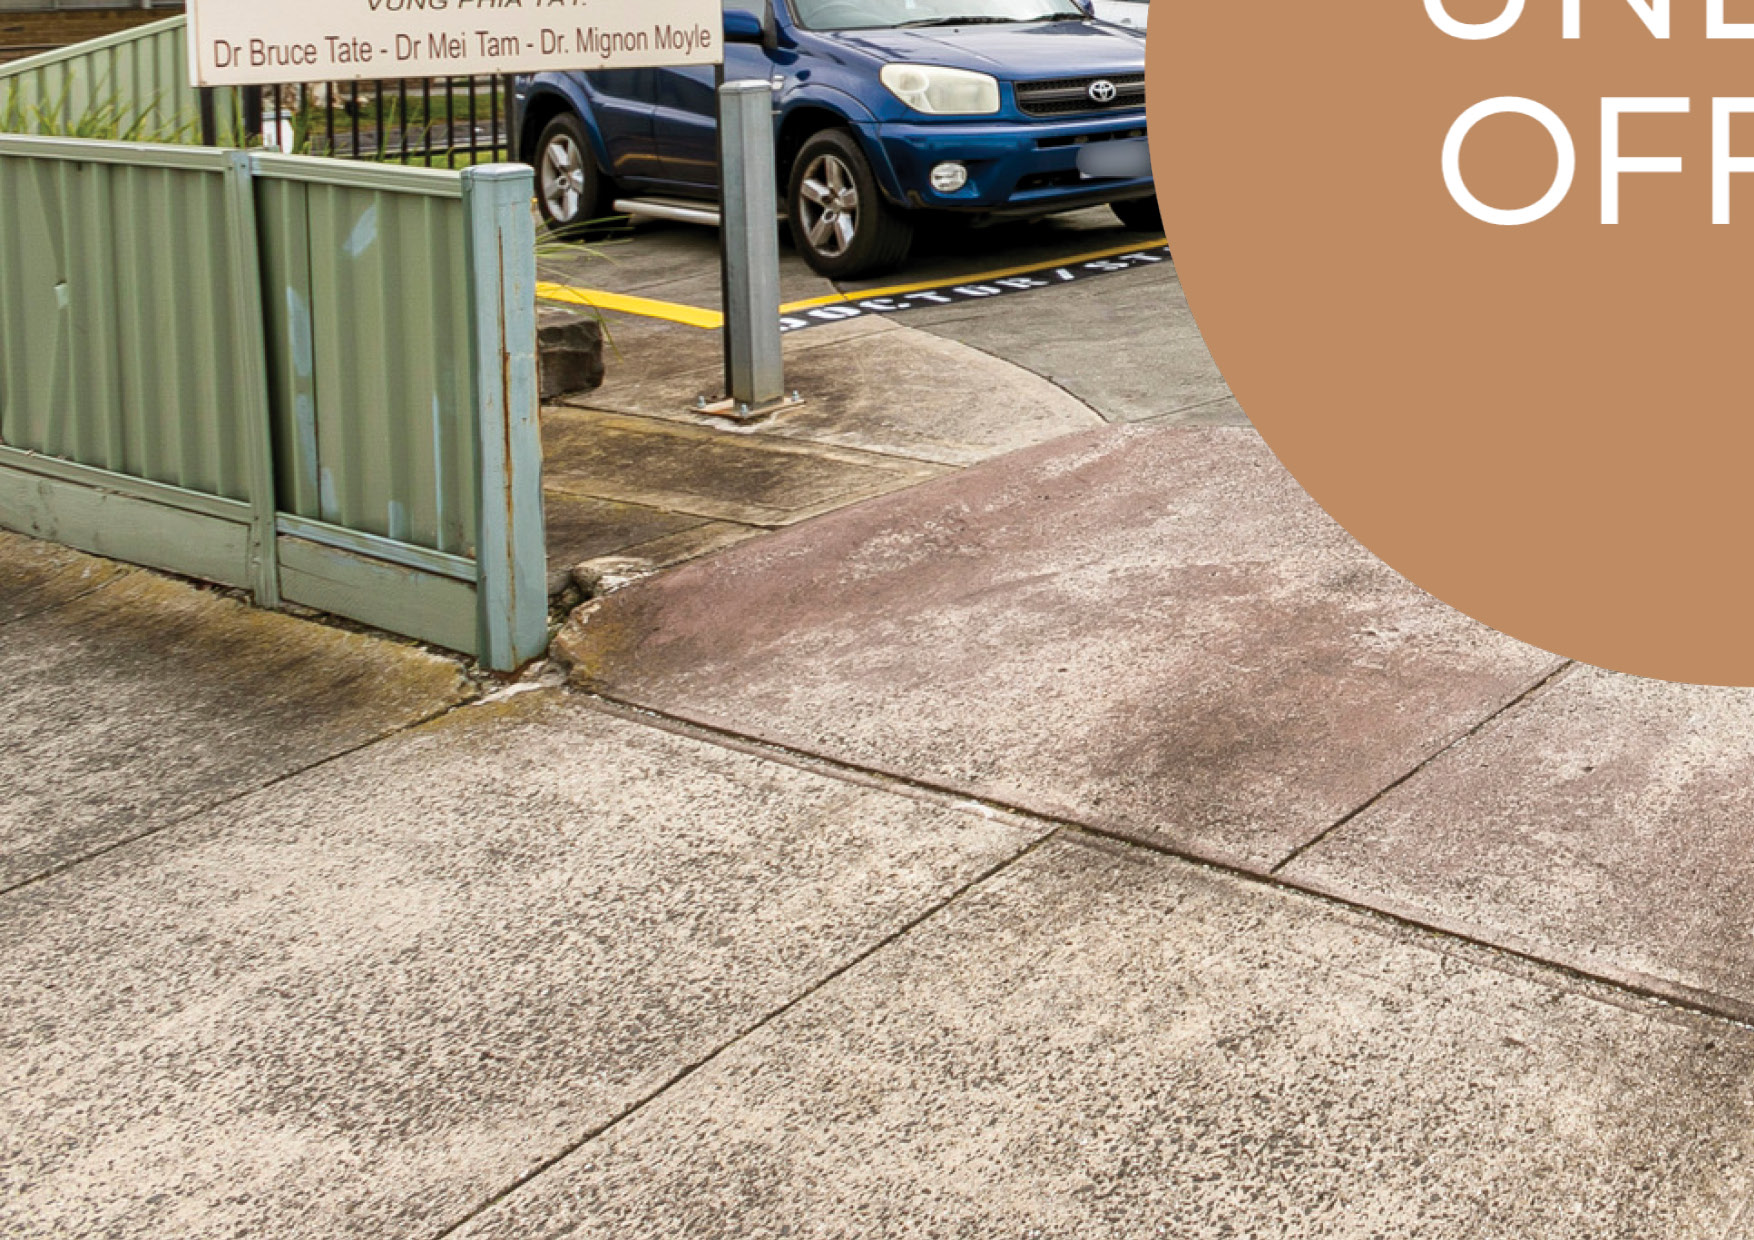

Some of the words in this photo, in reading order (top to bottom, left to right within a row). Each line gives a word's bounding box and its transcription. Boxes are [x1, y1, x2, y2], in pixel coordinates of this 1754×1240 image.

[213, 39, 242, 68] Dr
[249, 38, 317, 67] Bruce
[324, 35, 374, 64] Tate
[395, 33, 422, 61] Dr
[427, 31, 468, 59] Mei
[475, 30, 520, 57] Tam
[541, 28, 569, 55] Dr.
[576, 26, 649, 59] Mignon
[654, 23, 711, 55] Moyle
